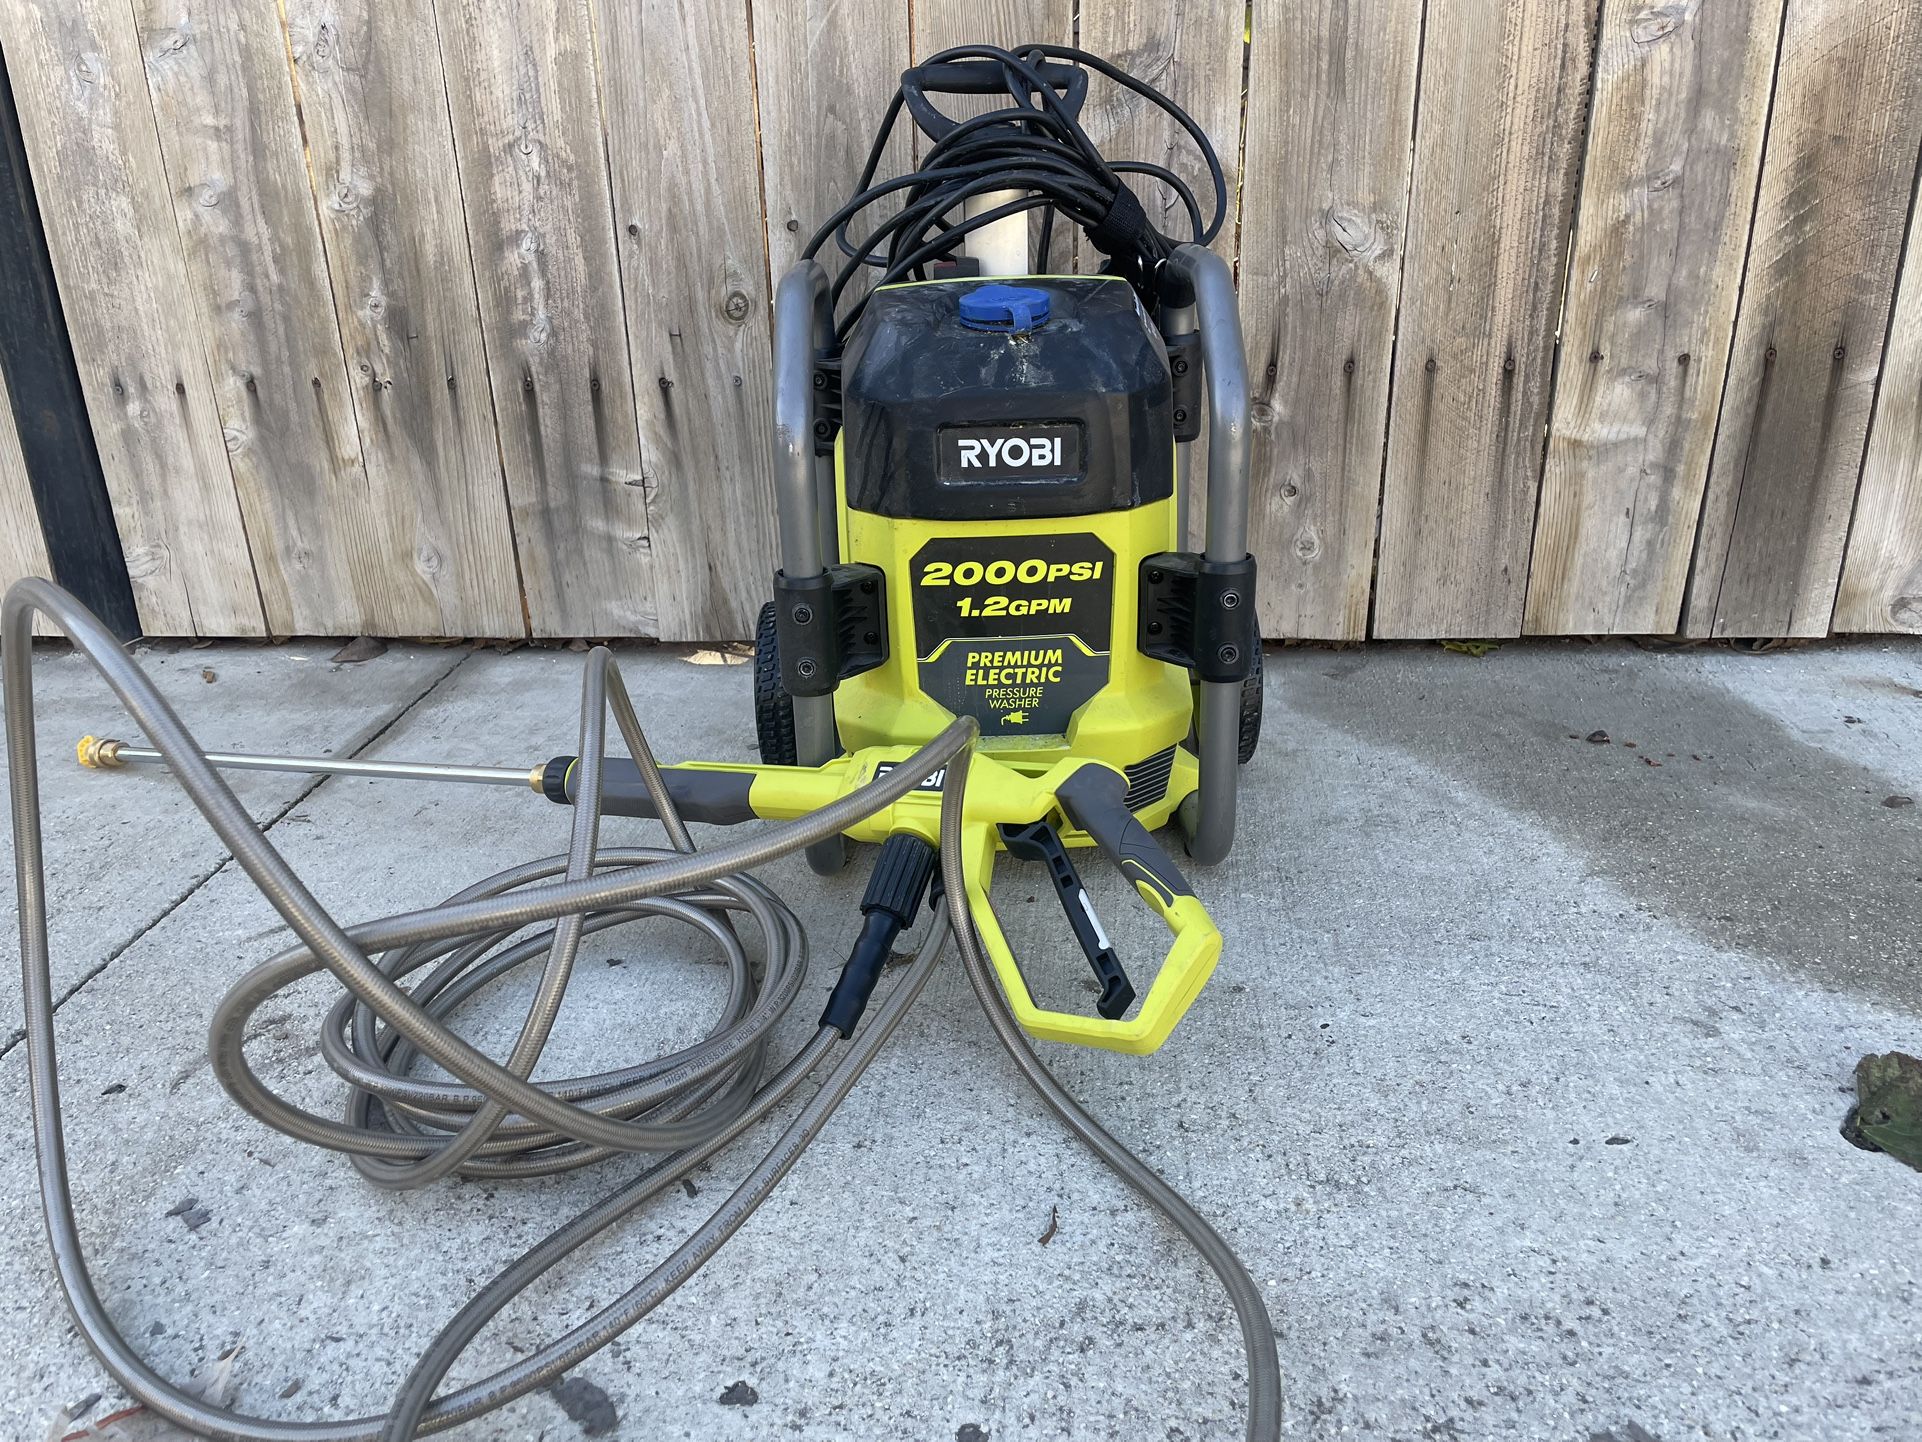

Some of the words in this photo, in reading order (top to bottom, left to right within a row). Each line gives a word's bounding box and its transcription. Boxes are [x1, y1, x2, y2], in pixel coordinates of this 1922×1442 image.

[957, 437, 1062, 468] RYOBI
[966, 648, 1063, 668] PREMIUM
[965, 666, 1063, 686] ELECTRIC
[985, 686, 1044, 699] PRESSURE
[988, 697, 1040, 710] WASHER
[663, 1069, 688, 1086] HIGH
[690, 1041, 736, 1072] PRESSURE
[663, 1259, 690, 1286] KEEP
[718, 1208, 745, 1234] FROM
